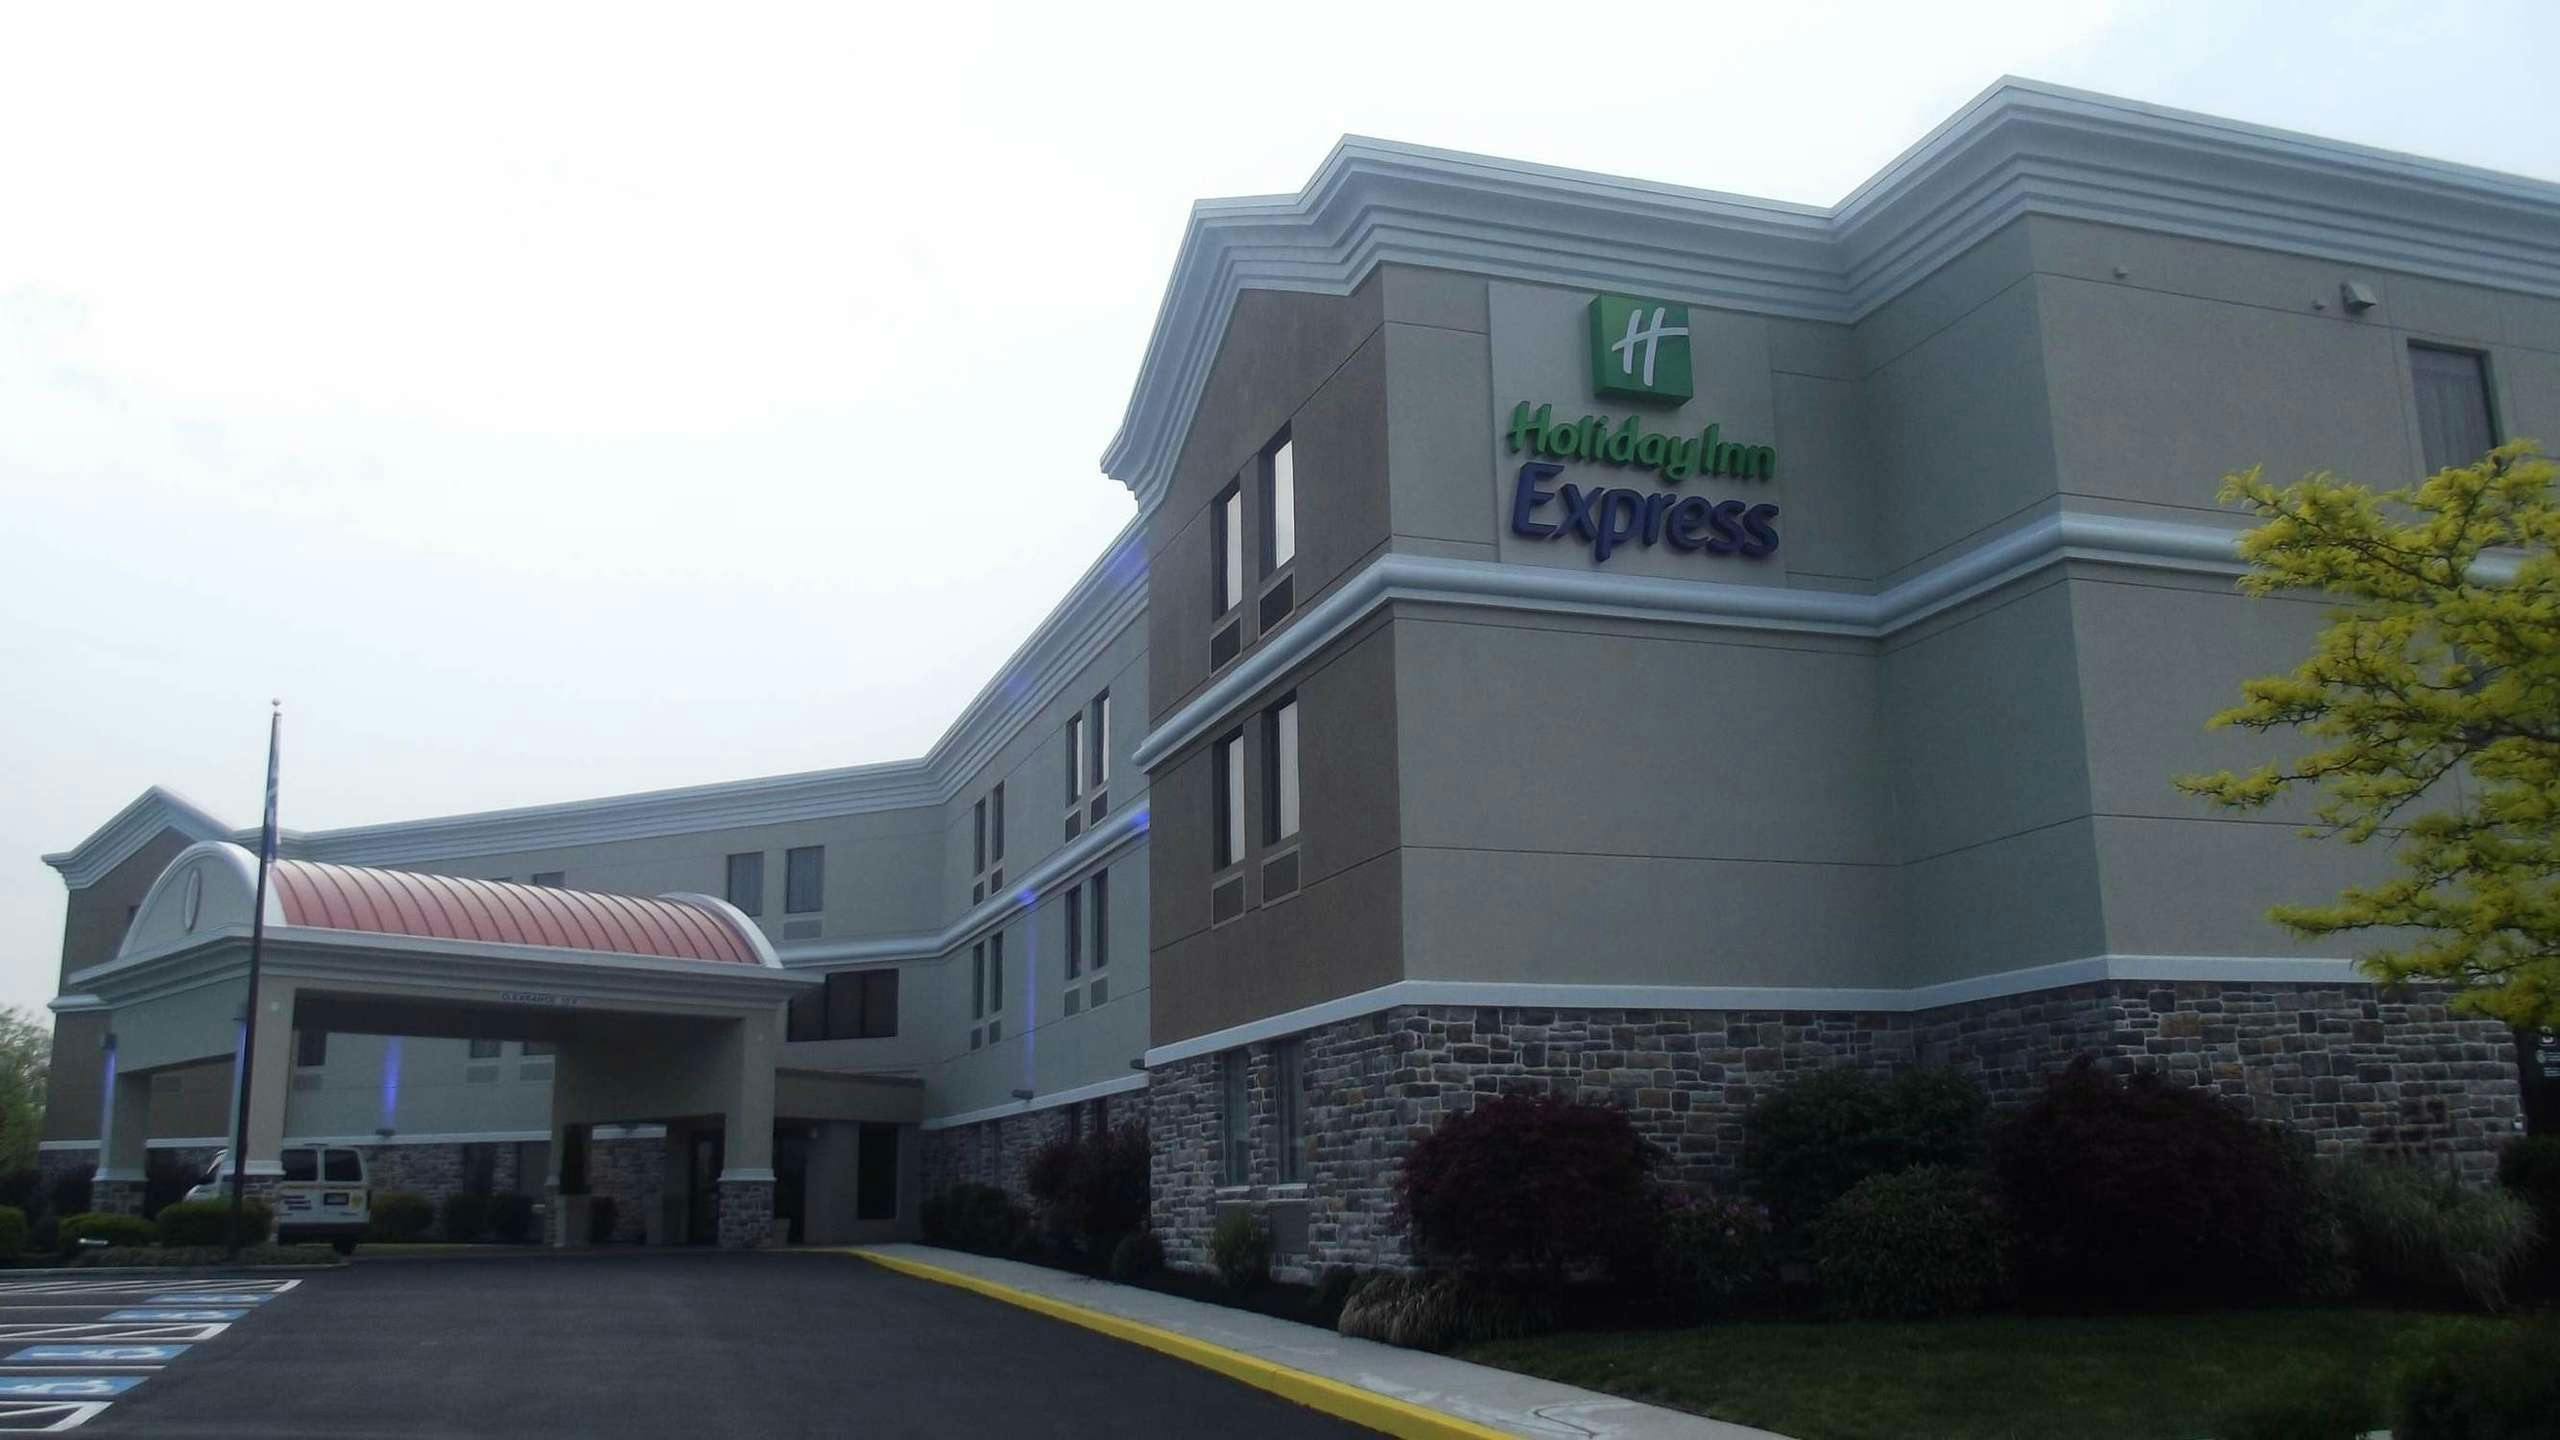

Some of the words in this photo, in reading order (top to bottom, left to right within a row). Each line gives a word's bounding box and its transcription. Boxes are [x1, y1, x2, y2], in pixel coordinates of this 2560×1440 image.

[1507, 400, 1698, 485] Holiday
[1701, 422, 1777, 481] Inn
[1511, 461, 1780, 562] Express
